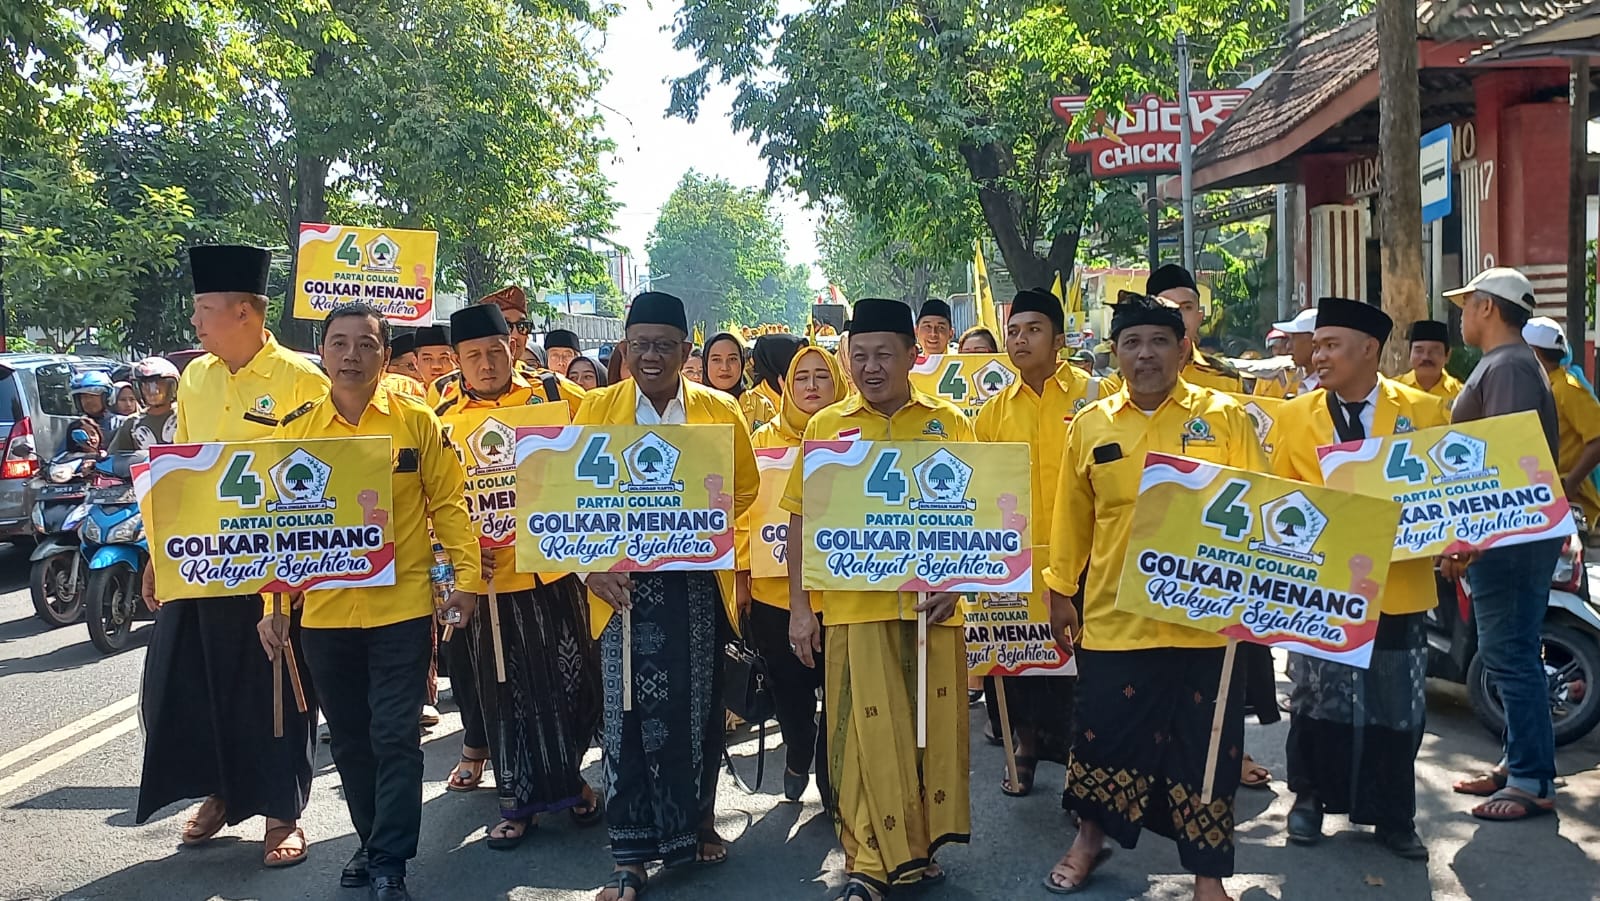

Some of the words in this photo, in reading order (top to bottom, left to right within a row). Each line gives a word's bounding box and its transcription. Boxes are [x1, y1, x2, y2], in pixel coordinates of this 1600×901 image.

[1099, 142, 1196, 170] CHICK
[1480, 160, 1494, 201] 17
[336, 234, 361, 266] 4
[304, 280, 360, 297] GOLKAR
[364, 285, 425, 300] MENANG
[334, 272, 364, 282] PARTAI
[366, 274, 399, 284] GOLKAR
[938, 363, 967, 400] 4
[577, 436, 615, 485] 4
[1386, 442, 1424, 482] 4
[219, 454, 262, 505] 4
[477, 475, 515, 489] GOLKA
[867, 452, 906, 502] 4
[1393, 488, 1442, 503] PARTAI
[1445, 479, 1500, 496] GOLKAR
[577, 496, 625, 509] PARTAI
[627, 496, 681, 508] GOLKAR
[1205, 482, 1250, 538] 4
[1399, 504, 1444, 525] KAR
[1448, 486, 1551, 517] MENANG
[220, 517, 273, 531] PARTAI
[276, 514, 334, 528] GOLKAR
[528, 512, 621, 533] GOLKAR
[627, 511, 724, 532] MENANG
[866, 514, 915, 526] PARTAI
[918, 514, 974, 526] GOLKAR
[1394, 520, 1452, 550] akyat
[1455, 510, 1545, 541] Sejahtera
[167, 532, 269, 558] GOLKAR
[276, 527, 381, 552] MENANG
[540, 534, 627, 563] Rakyat
[626, 533, 712, 563] Sejahtera
[816, 530, 911, 551] GOLKAR
[917, 530, 1018, 551] MENANG
[180, 556, 276, 587] Rakyat
[275, 550, 369, 582] Sejahtera
[828, 553, 913, 580] Rakyat
[917, 553, 1006, 582] Sejahtera
[1197, 544, 1252, 568] PARTAI
[1255, 557, 1318, 582] GOLKAR
[1139, 551, 1243, 593] GOLKAR
[1248, 575, 1365, 620] MENANG
[963, 612, 989, 623] ARTAI
[991, 610, 1029, 622] GOLKAR
[1148, 577, 1246, 618] Rakyat
[1242, 600, 1343, 642] Sejahtera
[993, 623, 1052, 643] MENAN
[997, 643, 1057, 667] Sejahtera
